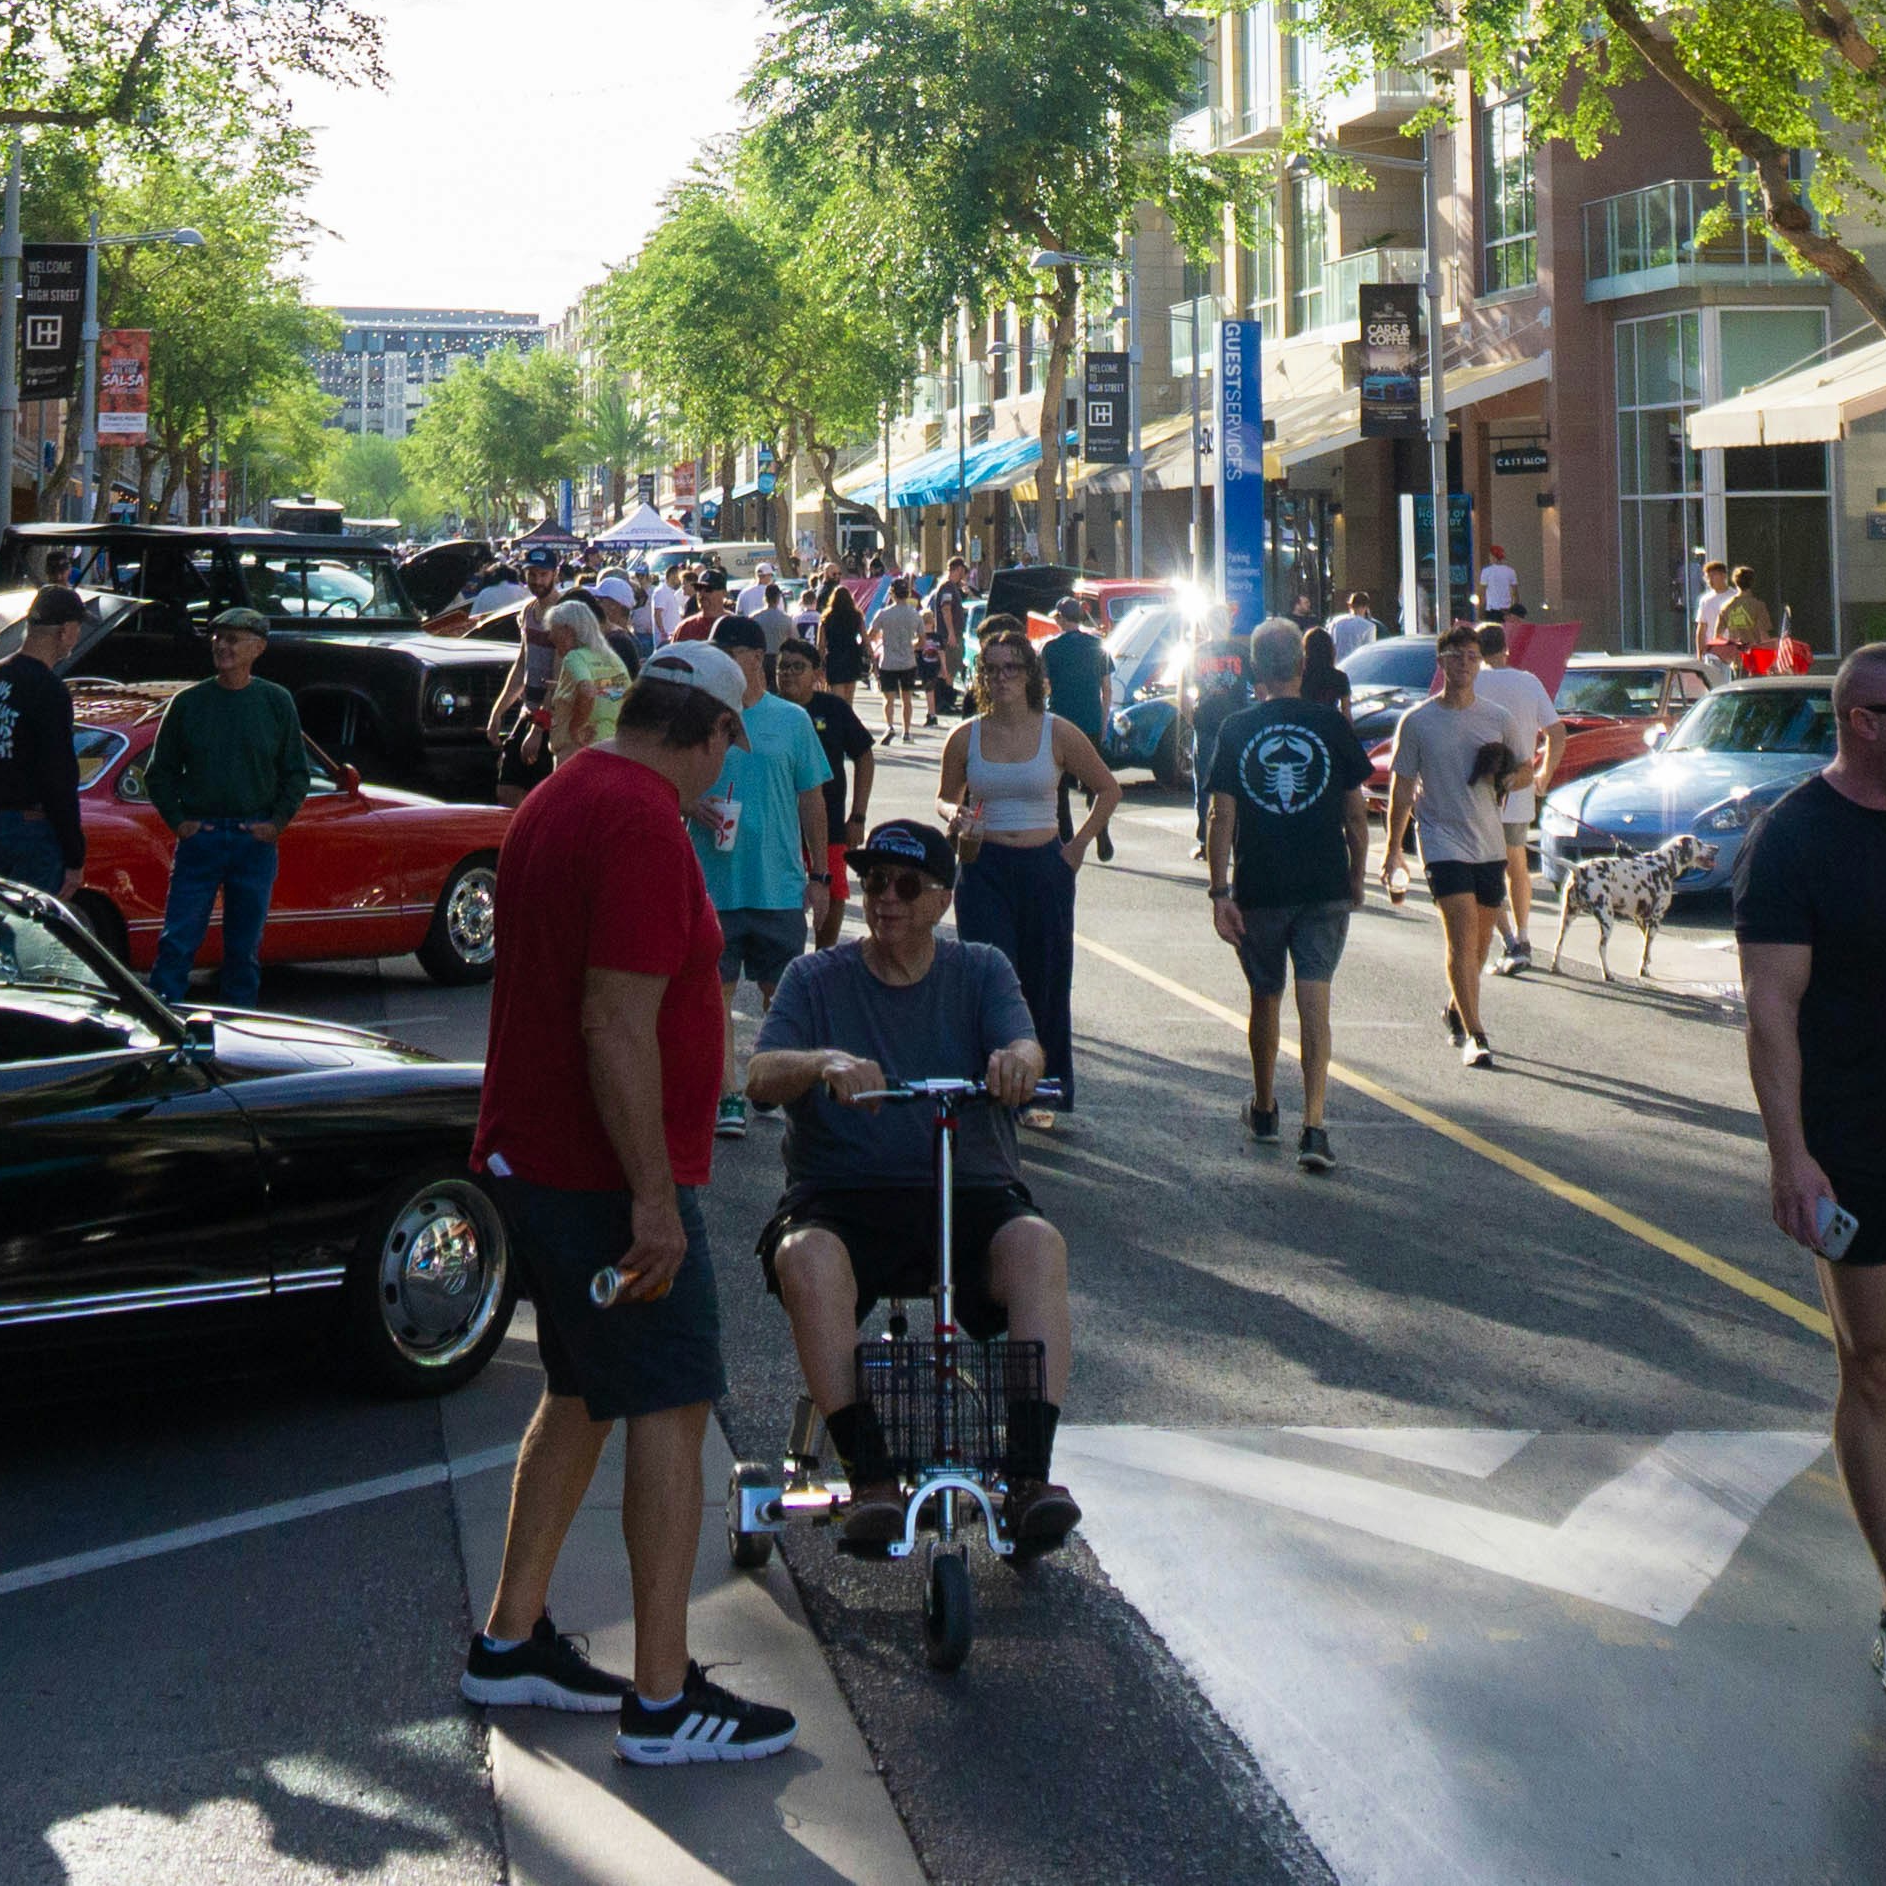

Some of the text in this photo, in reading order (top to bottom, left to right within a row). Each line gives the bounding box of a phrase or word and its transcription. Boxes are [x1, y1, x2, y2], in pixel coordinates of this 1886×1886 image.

[28, 261, 73, 274] WELCOME
[28, 275, 40, 287] TO
[27, 289, 80, 301] HIGH STREET
[1368, 324, 1399, 335] CARS
[1368, 335, 1410, 346] COFFEE
[102, 374, 145, 387] SALSA
[805, 625, 815, 644] 4
